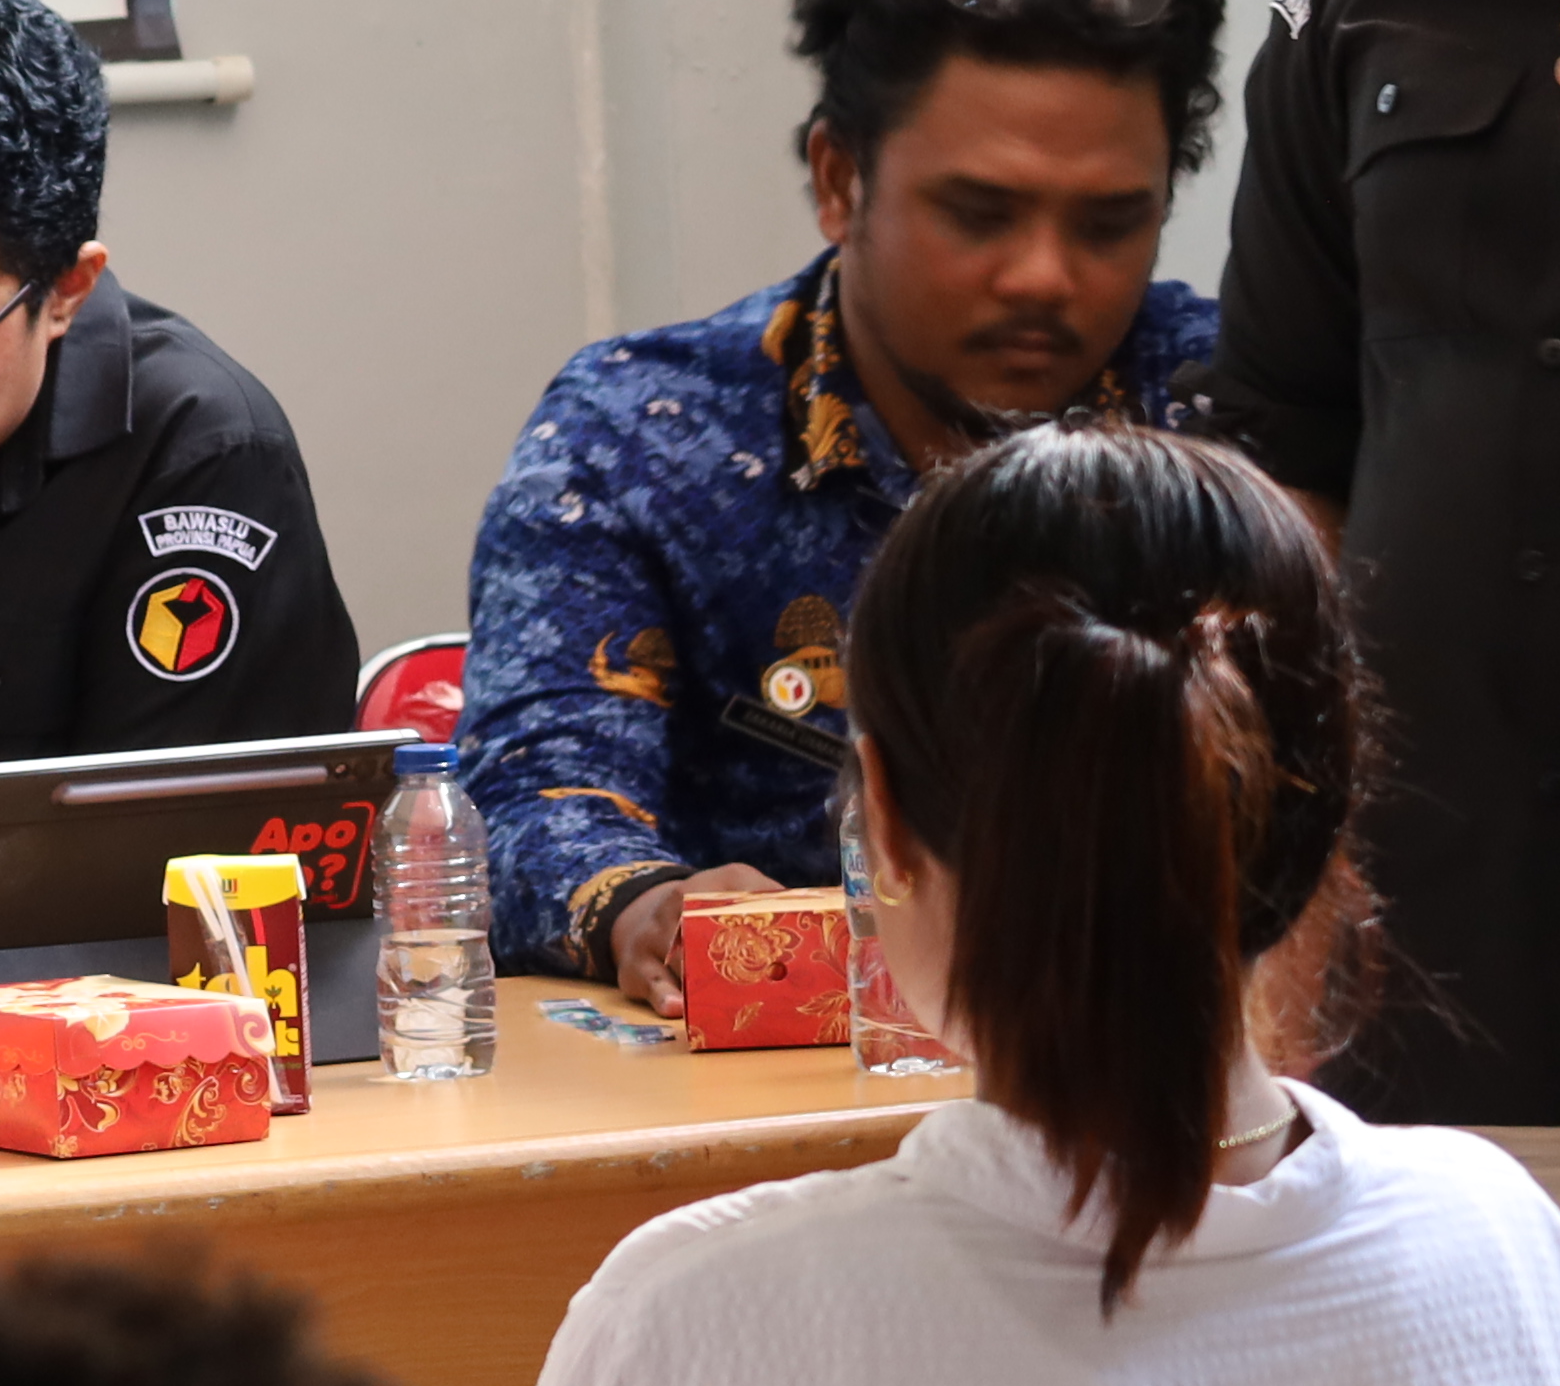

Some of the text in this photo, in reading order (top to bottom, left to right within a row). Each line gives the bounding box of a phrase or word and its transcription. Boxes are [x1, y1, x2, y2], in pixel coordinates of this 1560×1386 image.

[155, 530, 215, 550] PROVINSI
[163, 512, 250, 540] BAWASLU
[250, 817, 358, 855] Apo
